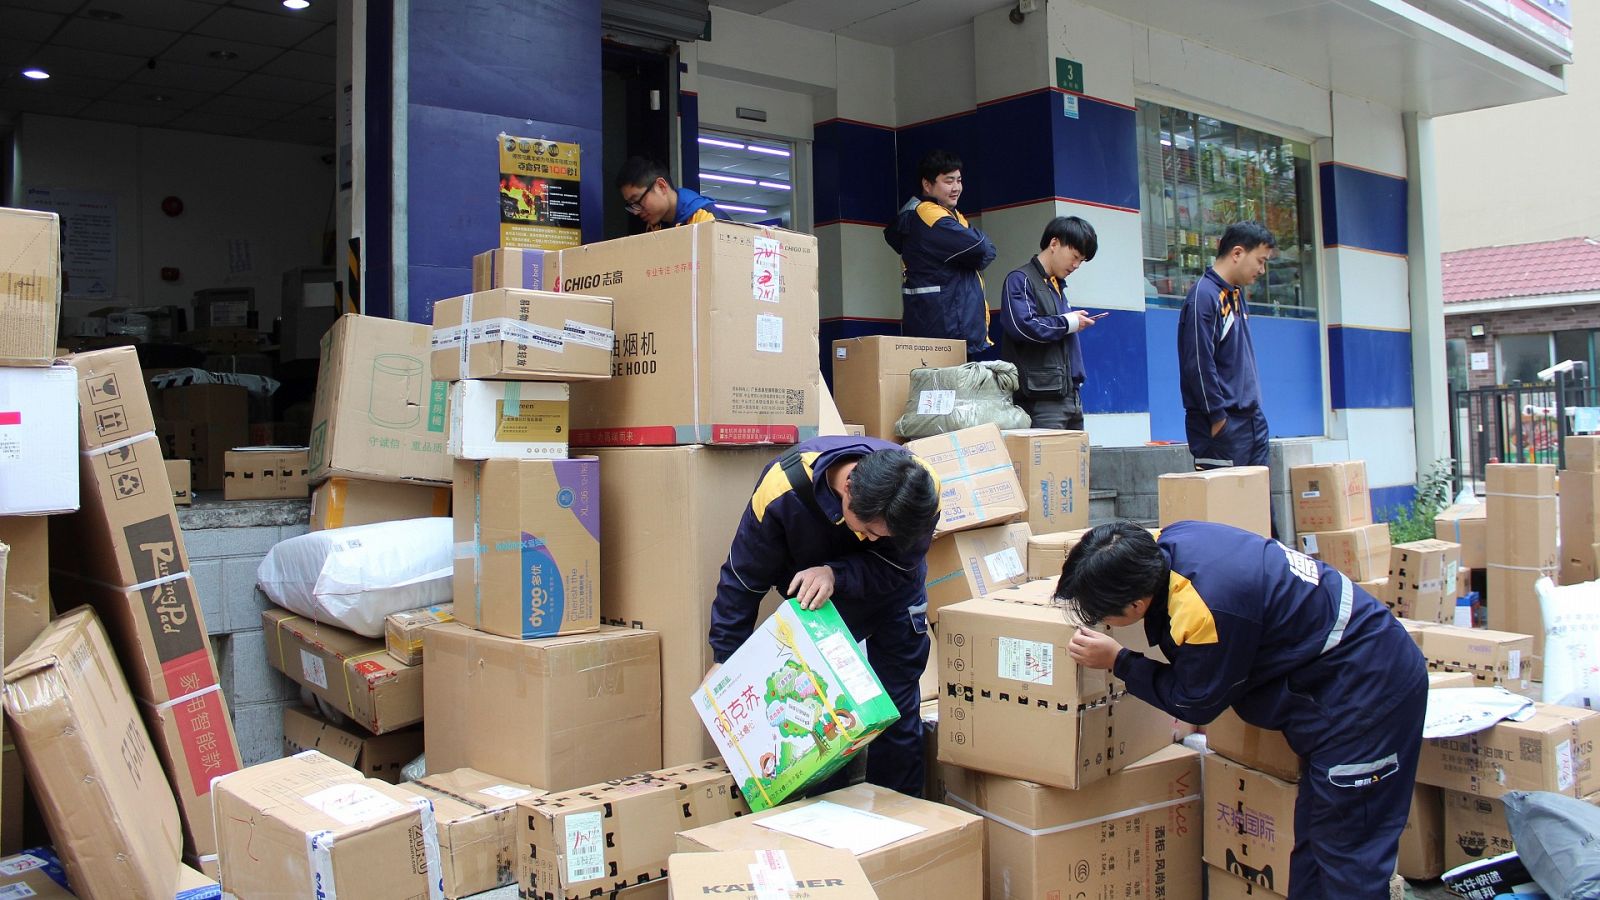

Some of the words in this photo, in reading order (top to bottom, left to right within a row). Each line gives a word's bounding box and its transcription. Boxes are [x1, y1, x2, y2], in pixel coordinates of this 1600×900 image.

[1067, 64, 1074, 80] 3
[564, 274, 601, 292] CHIGO
[602, 270, 623, 287] 志高
[626, 361, 657, 376] HOOD
[1061, 480, 1068, 498] 40
[1061, 499, 1068, 513] XL
[530, 564, 542, 587] 多优
[180, 671, 221, 773] 家用智能款
[714, 684, 761, 738] 阿克苏
[1217, 802, 1275, 843] 天猫国际
[1154, 825, 1166, 900] 酒柜-风尚系
[702, 878, 846, 894] KÄER
[1451, 870, 1503, 893] 大件快递
